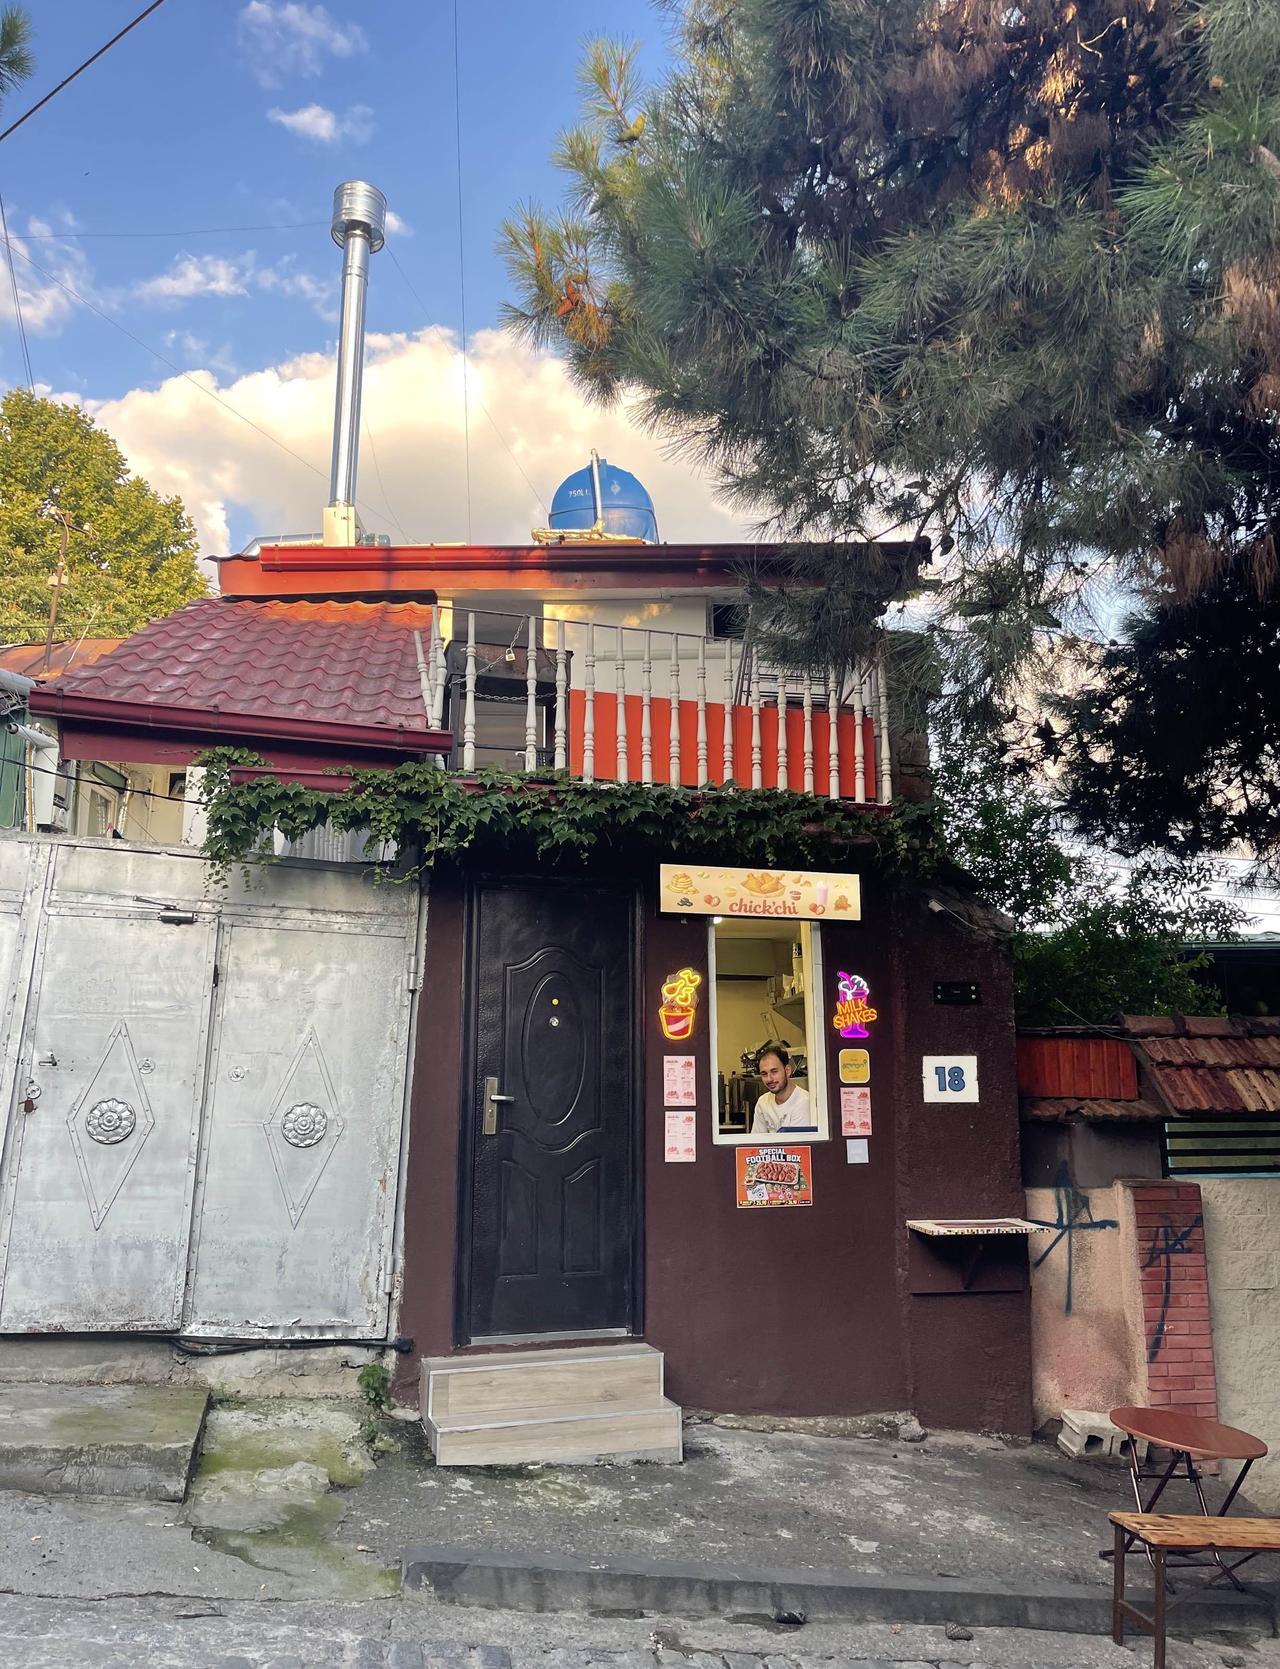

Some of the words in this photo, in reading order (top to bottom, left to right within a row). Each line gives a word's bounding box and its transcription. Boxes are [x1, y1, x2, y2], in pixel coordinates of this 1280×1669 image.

[728, 898, 799, 915] chick'chi
[836, 998, 869, 1015] MILK
[833, 1008, 877, 1030] SHAKES
[935, 1066, 966, 1092] 18
[745, 1154, 786, 1165] FOOTBALL
[786, 1154, 801, 1162] BOX
